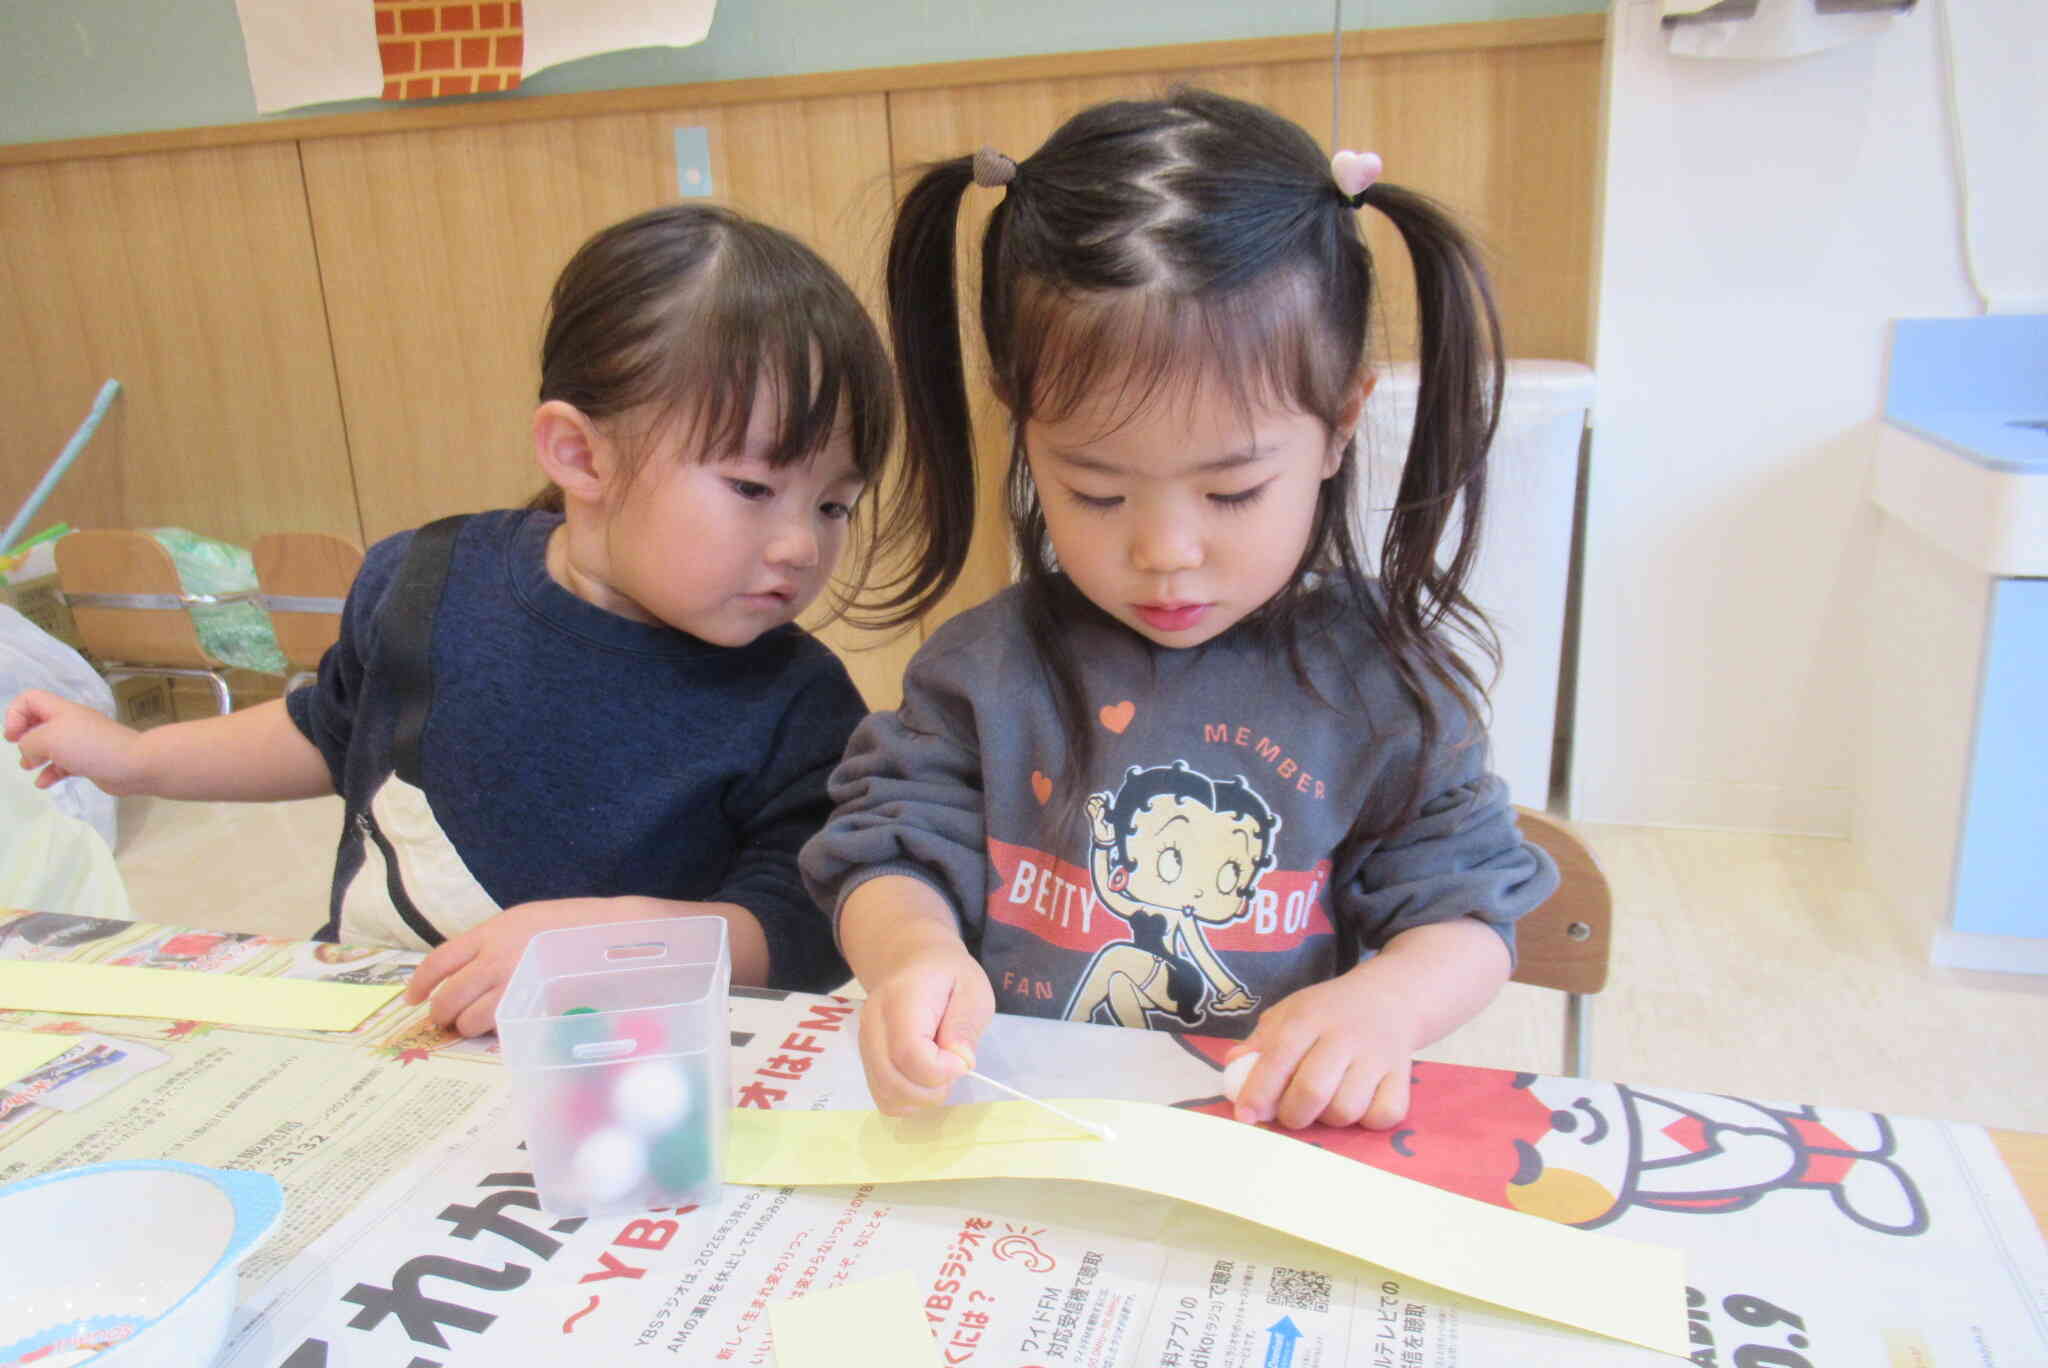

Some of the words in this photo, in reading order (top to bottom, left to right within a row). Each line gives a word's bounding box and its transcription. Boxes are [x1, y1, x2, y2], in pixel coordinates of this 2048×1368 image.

[1204, 723, 1325, 800] MEMBER
[1008, 860, 1098, 934] BETTY
[1003, 971, 1054, 1000] FAN
[736, 995, 855, 1110] オはFM
[926, 1216, 993, 1337] YBSラジオを
[943, 1289, 996, 1368] くには？
[1020, 1286, 1063, 1352] ワイドFM
